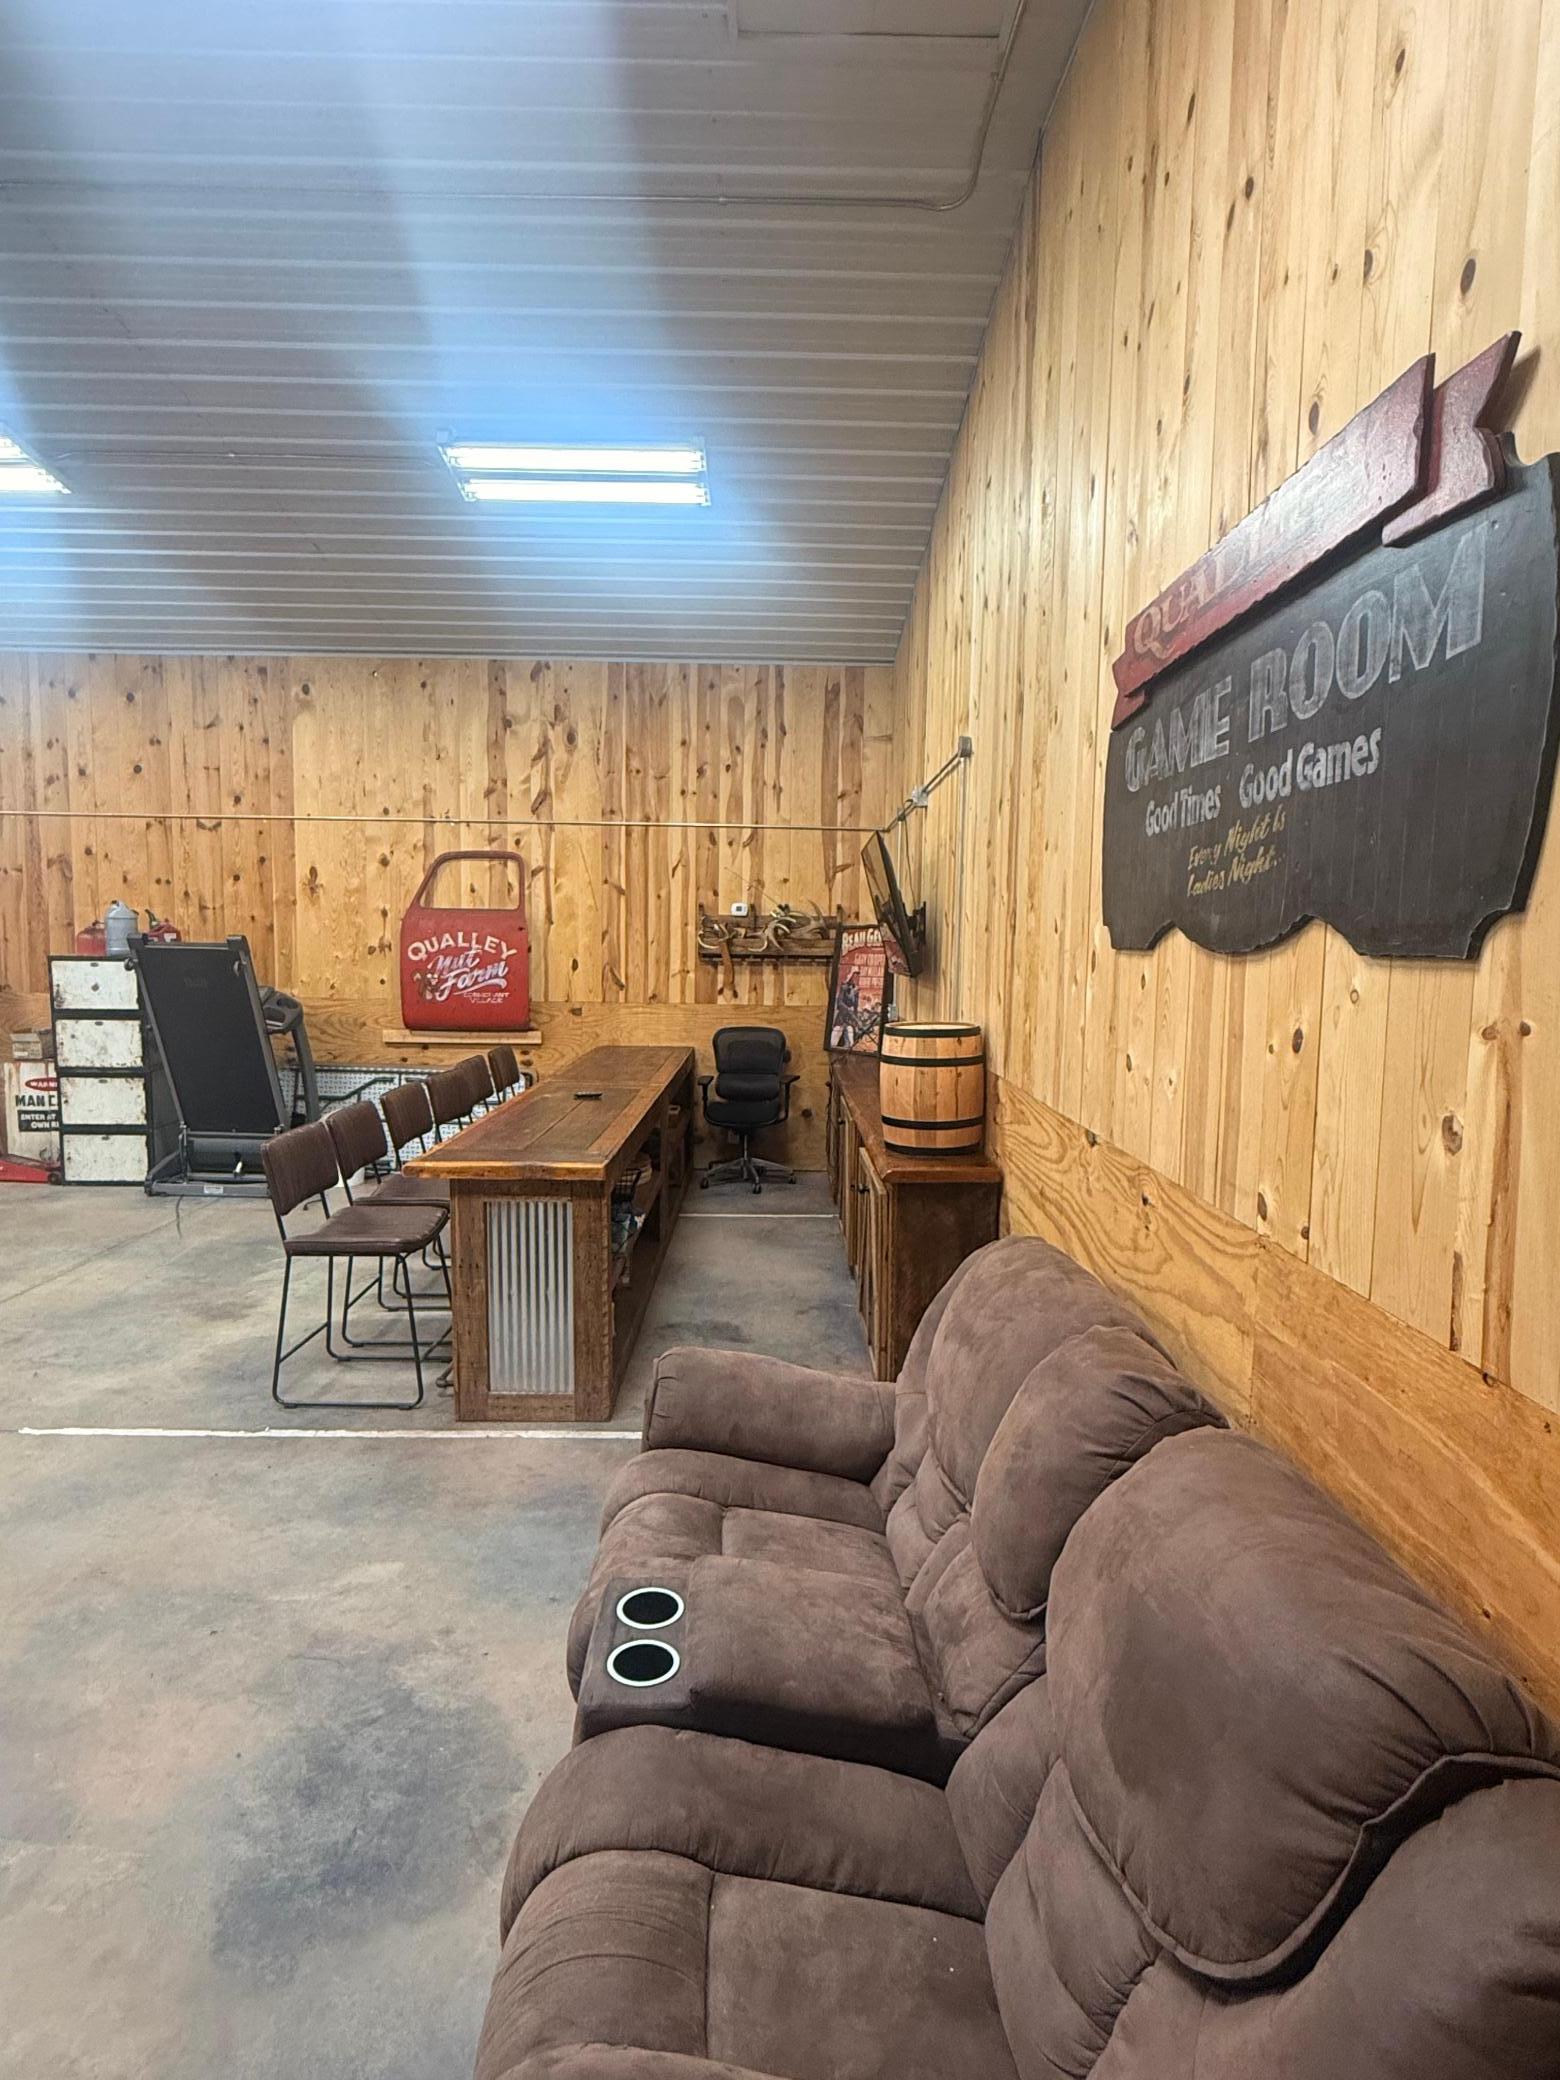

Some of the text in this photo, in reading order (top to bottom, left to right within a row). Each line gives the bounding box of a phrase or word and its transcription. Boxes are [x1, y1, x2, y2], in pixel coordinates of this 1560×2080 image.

[1125, 520, 1488, 792] GAME ROOM
[1145, 728, 1382, 837] Good Times Good Games
[1223, 818, 1271, 857] Night
[407, 931, 518, 961] QUALLEY
[435, 961, 509, 1001] Farm
[15, 1095, 45, 1107] MAN
